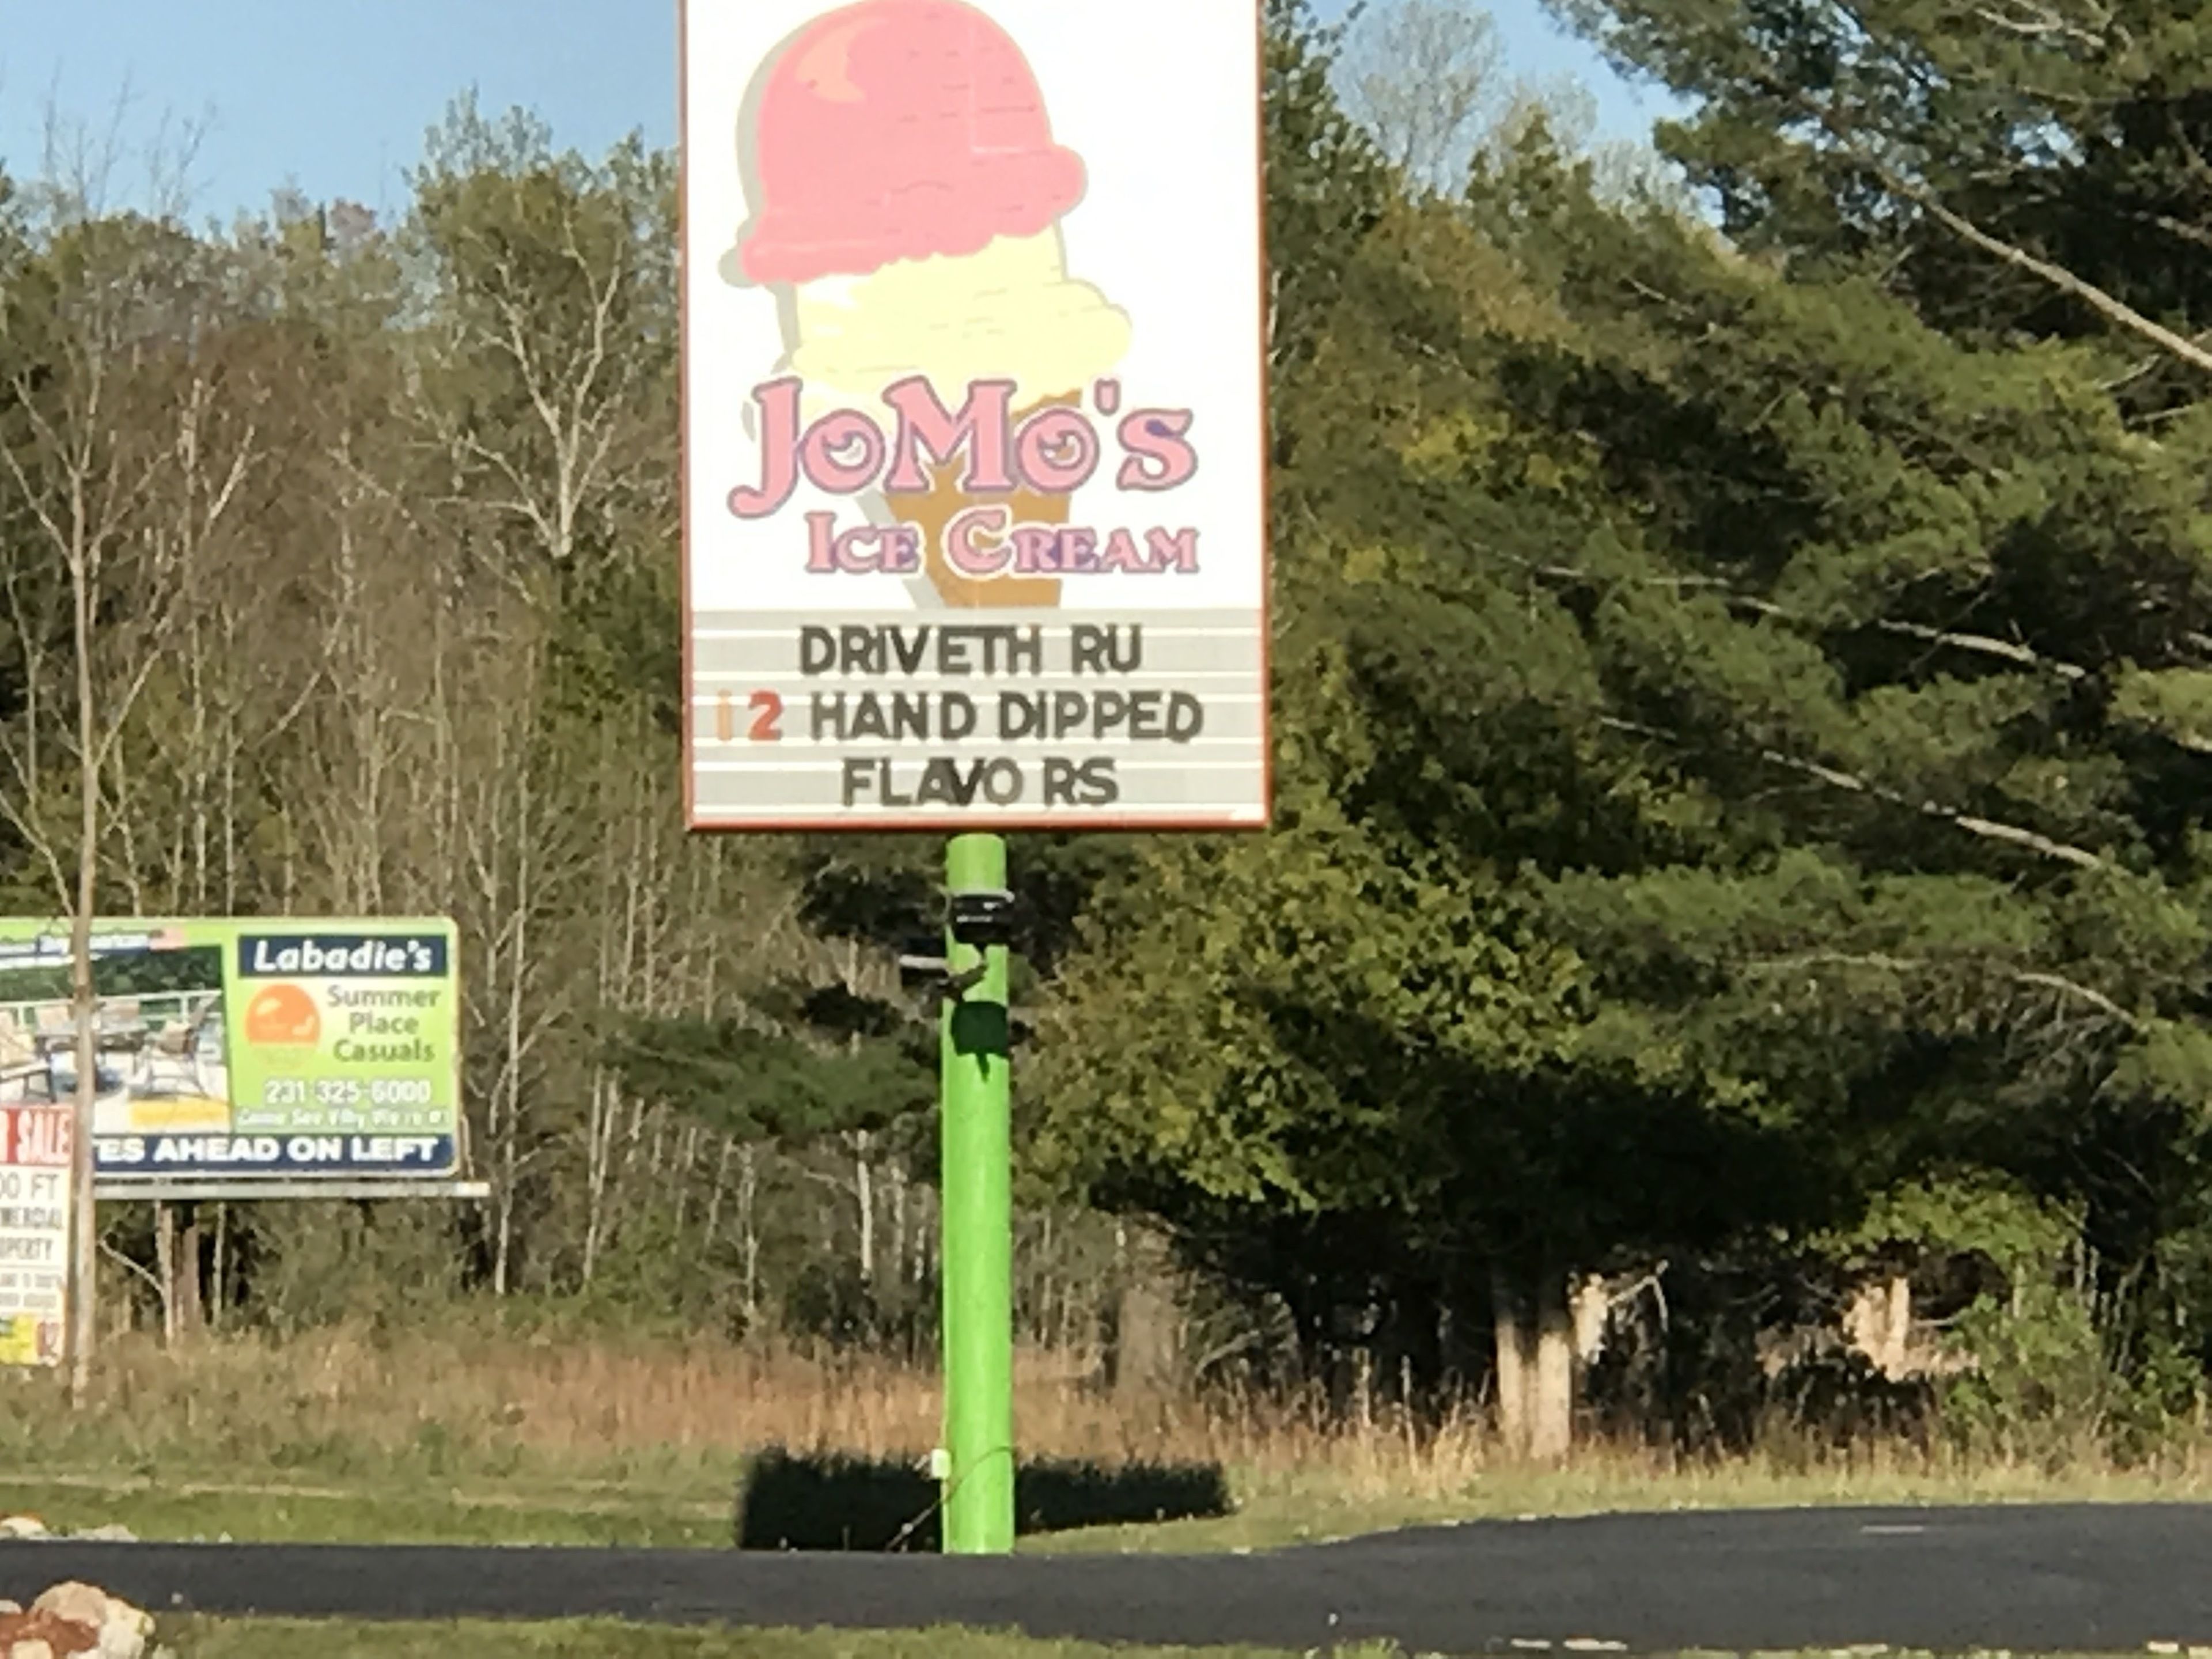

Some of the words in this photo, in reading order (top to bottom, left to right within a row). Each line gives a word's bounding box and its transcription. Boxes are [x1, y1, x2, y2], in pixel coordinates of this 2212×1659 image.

[811, 690, 976, 741] HAND
[998, 691, 1203, 742] DIPPED
[253, 939, 431, 972] Labadie's
[327, 984, 441, 1008] Summer
[349, 1011, 419, 1035] Place
[333, 1039, 435, 1062] Casuals
[17, 1109, 70, 1163] SALE
[152, 1137, 280, 1162] AHEAD
[287, 1137, 342, 1162] ON
[350, 1136, 438, 1161] LEFT
[31, 1173, 59, 1200] FT
